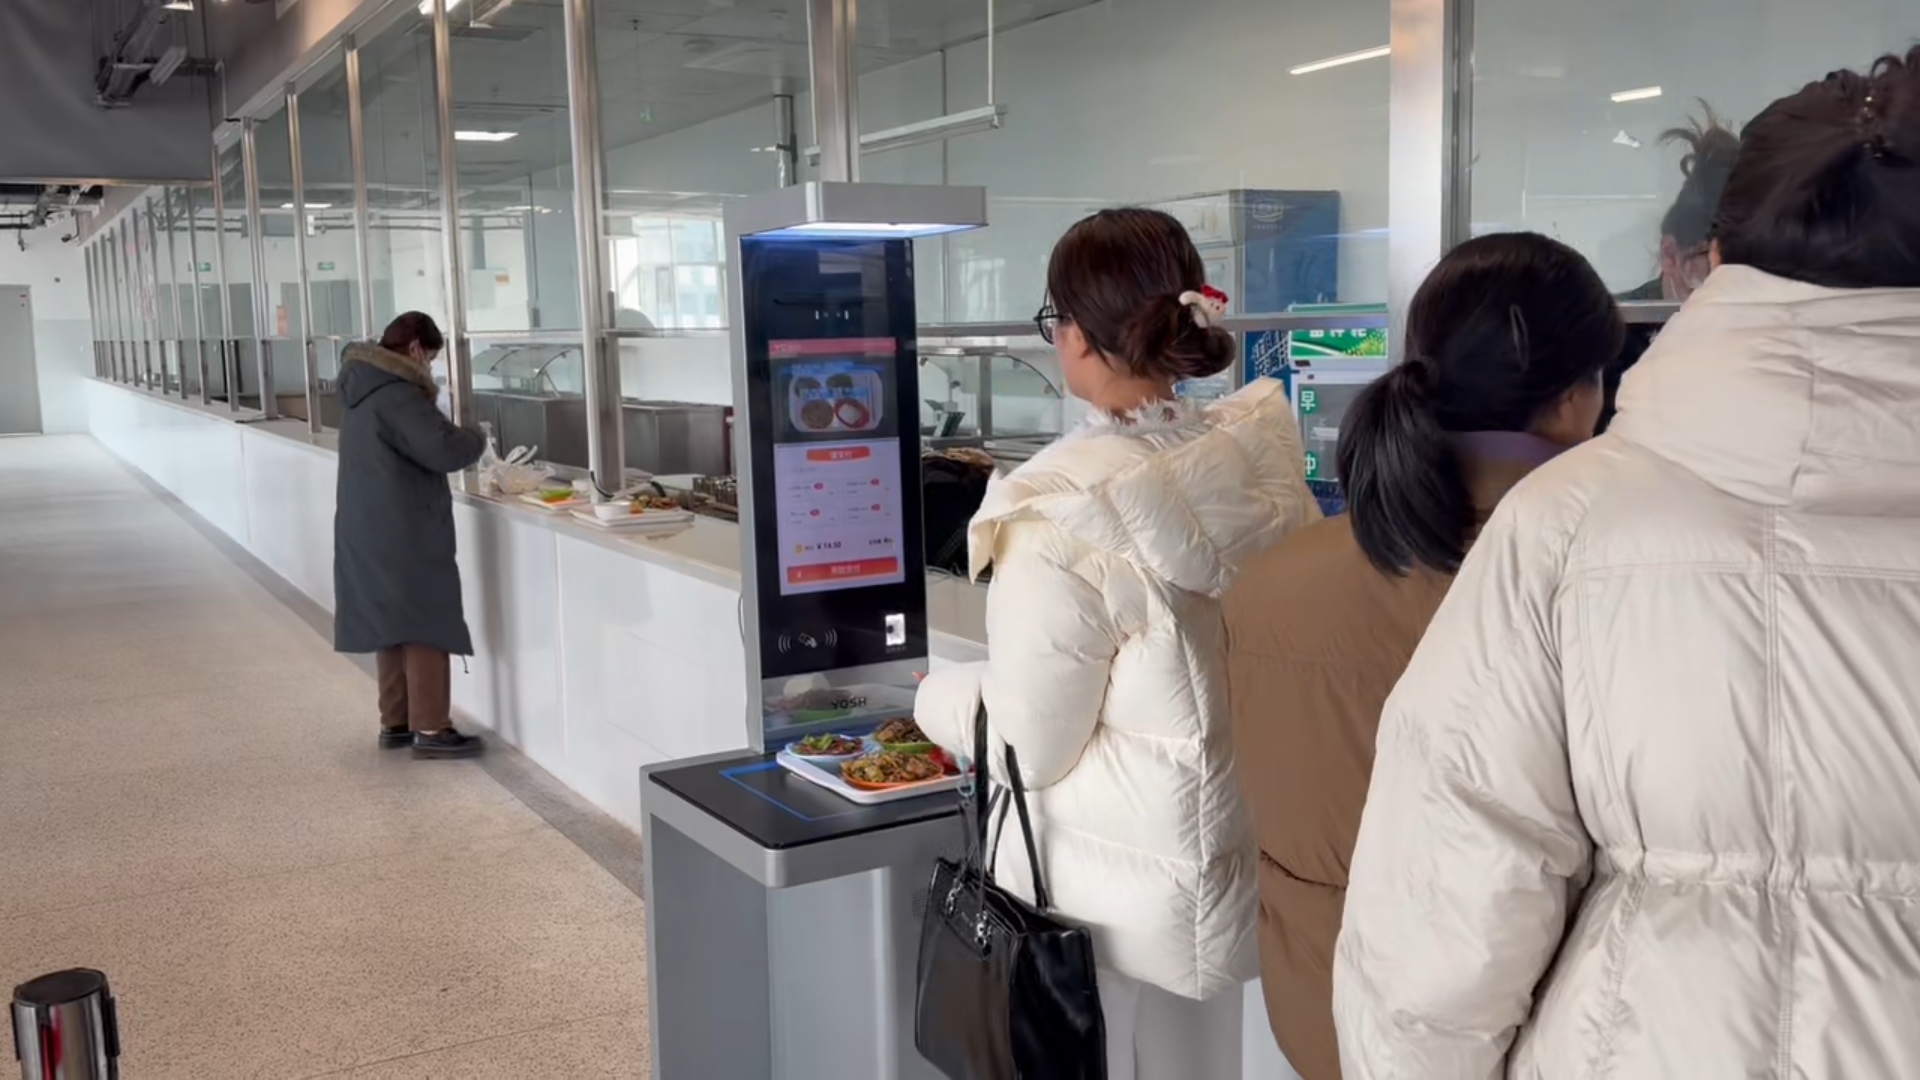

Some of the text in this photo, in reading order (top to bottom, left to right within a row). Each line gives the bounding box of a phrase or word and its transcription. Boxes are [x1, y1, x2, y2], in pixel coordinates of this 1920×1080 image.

[1300, 390, 1316, 411] 早
[1305, 453, 1317, 476] 中
[831, 697, 867, 709] YOSH
